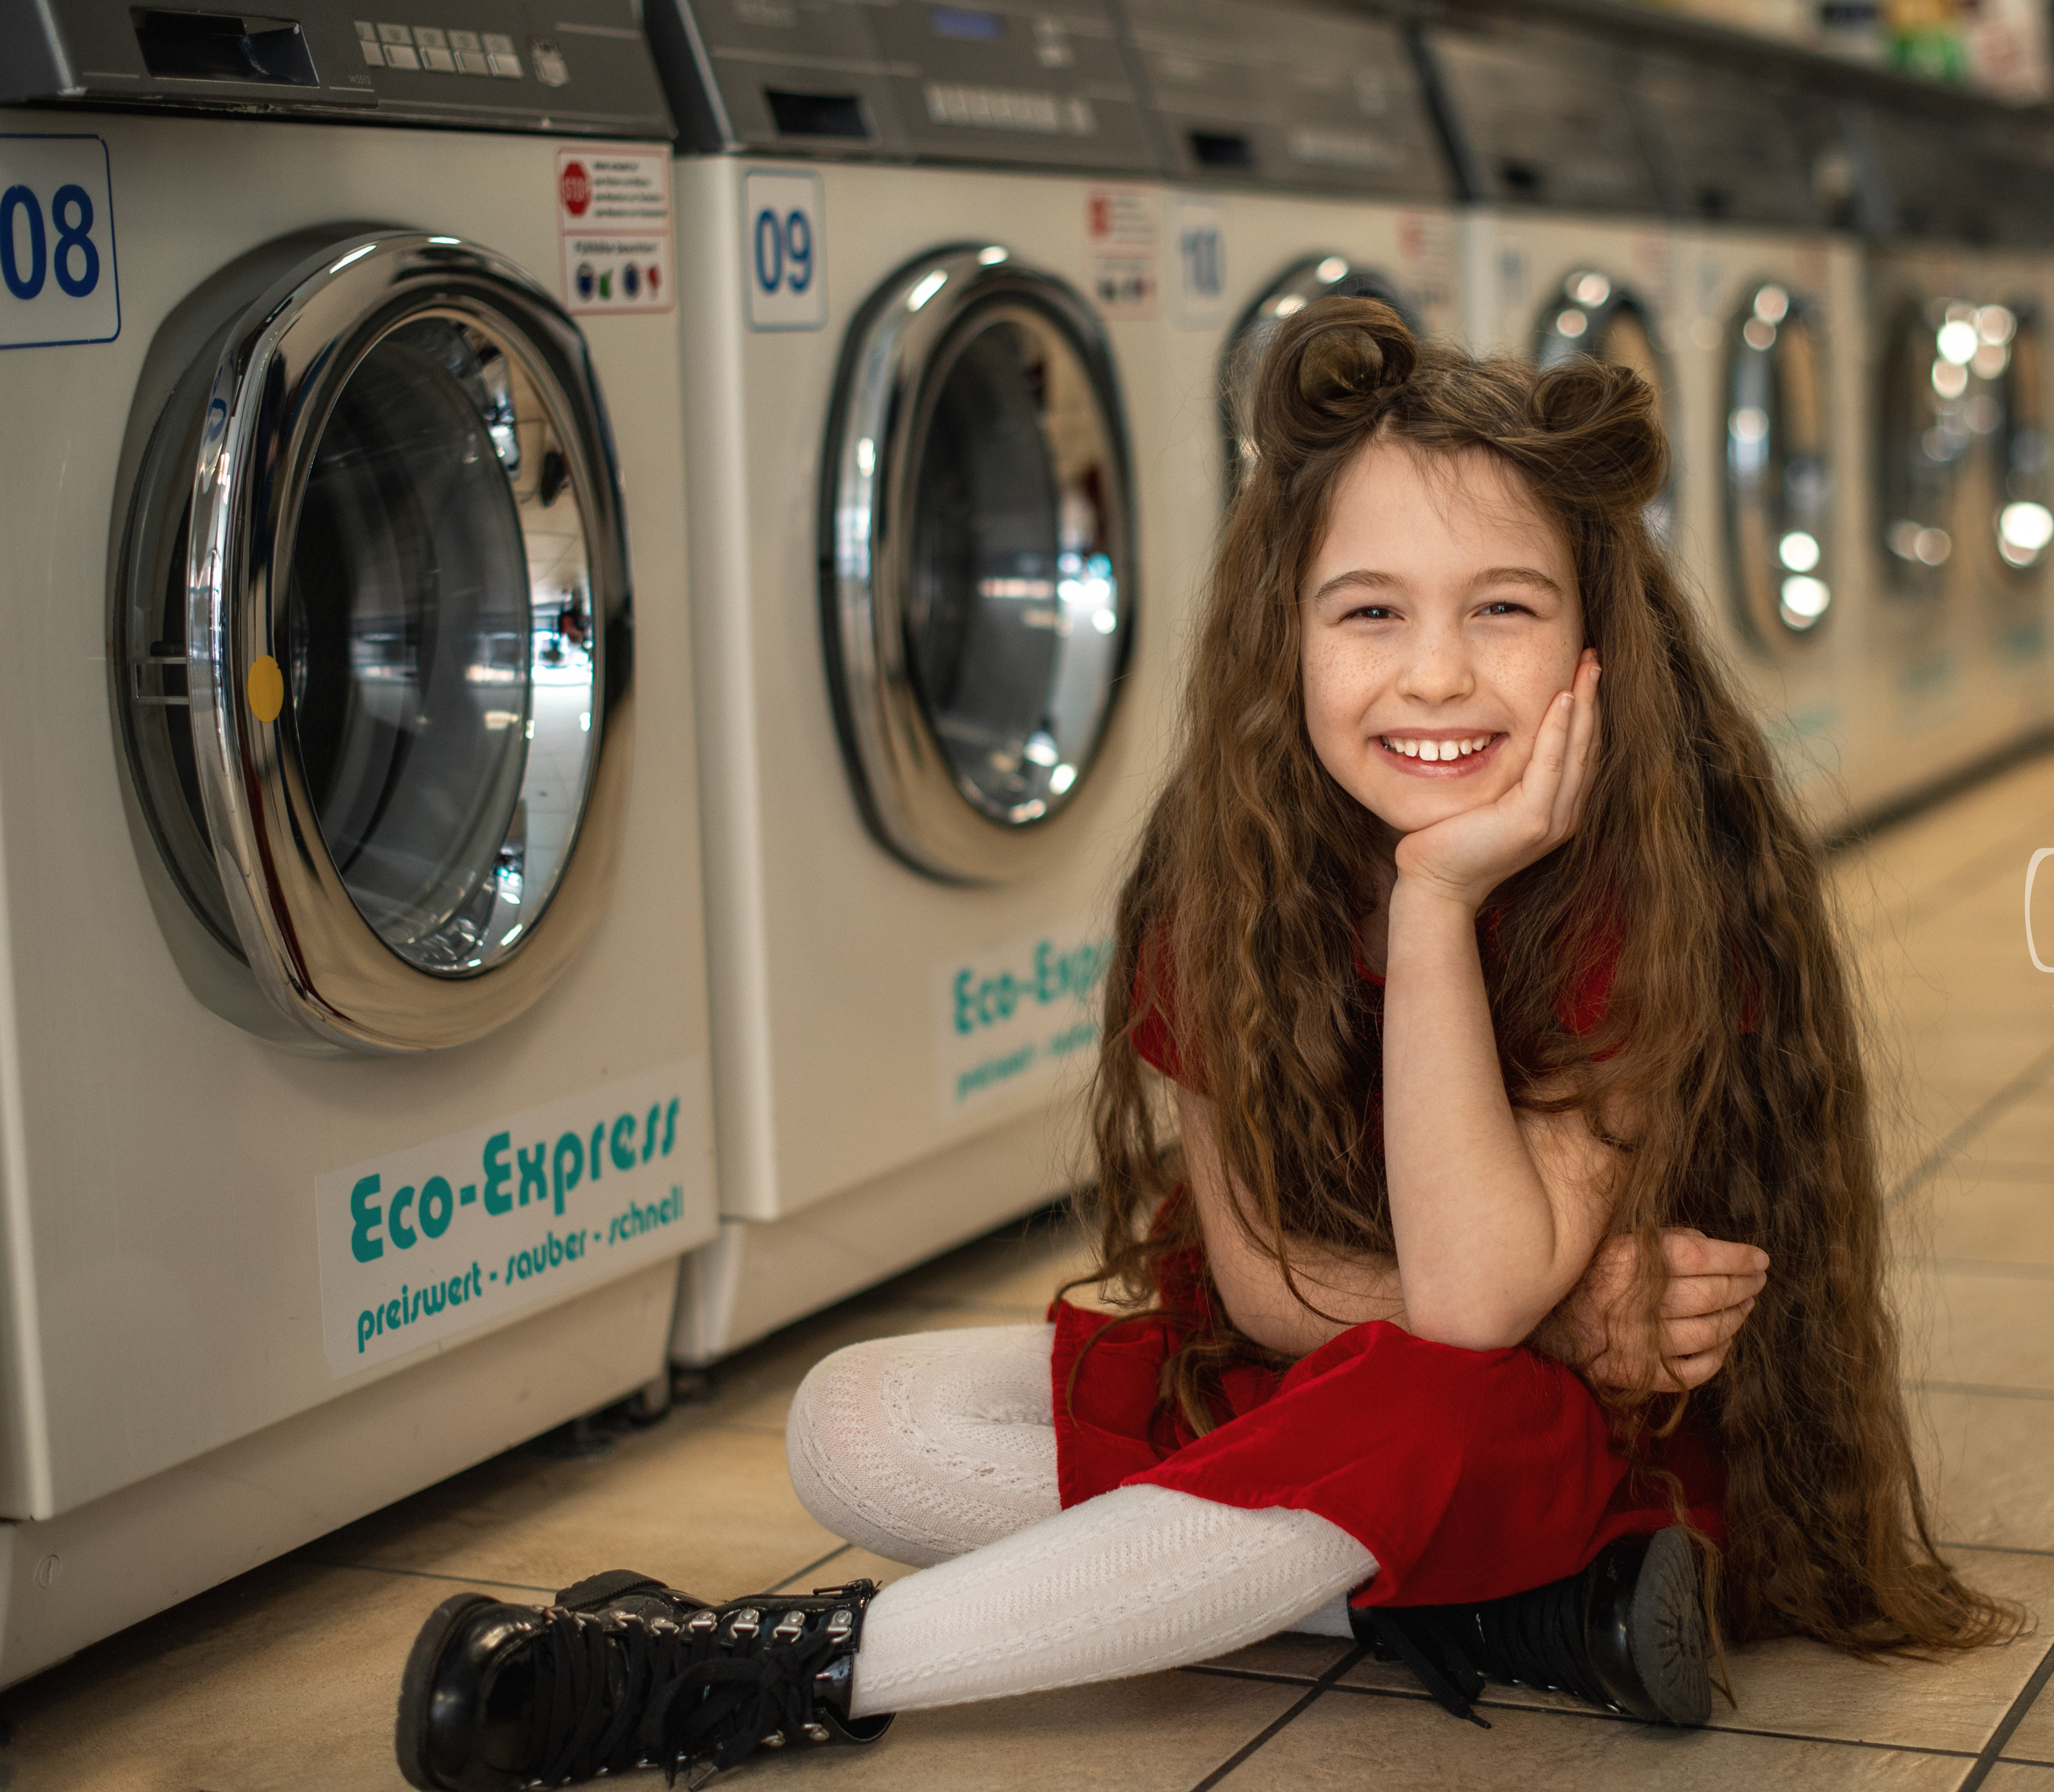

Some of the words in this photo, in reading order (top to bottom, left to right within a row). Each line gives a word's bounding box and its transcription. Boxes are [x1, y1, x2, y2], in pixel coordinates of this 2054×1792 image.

[0, 184, 99, 300] 08
[754, 209, 813, 294] 09
[350, 1097, 680, 1263] Eco-Express
[358, 1262, 482, 1354] preiswert
[505, 1230, 587, 1286] sauber
[608, 1184, 684, 1247] schnell
